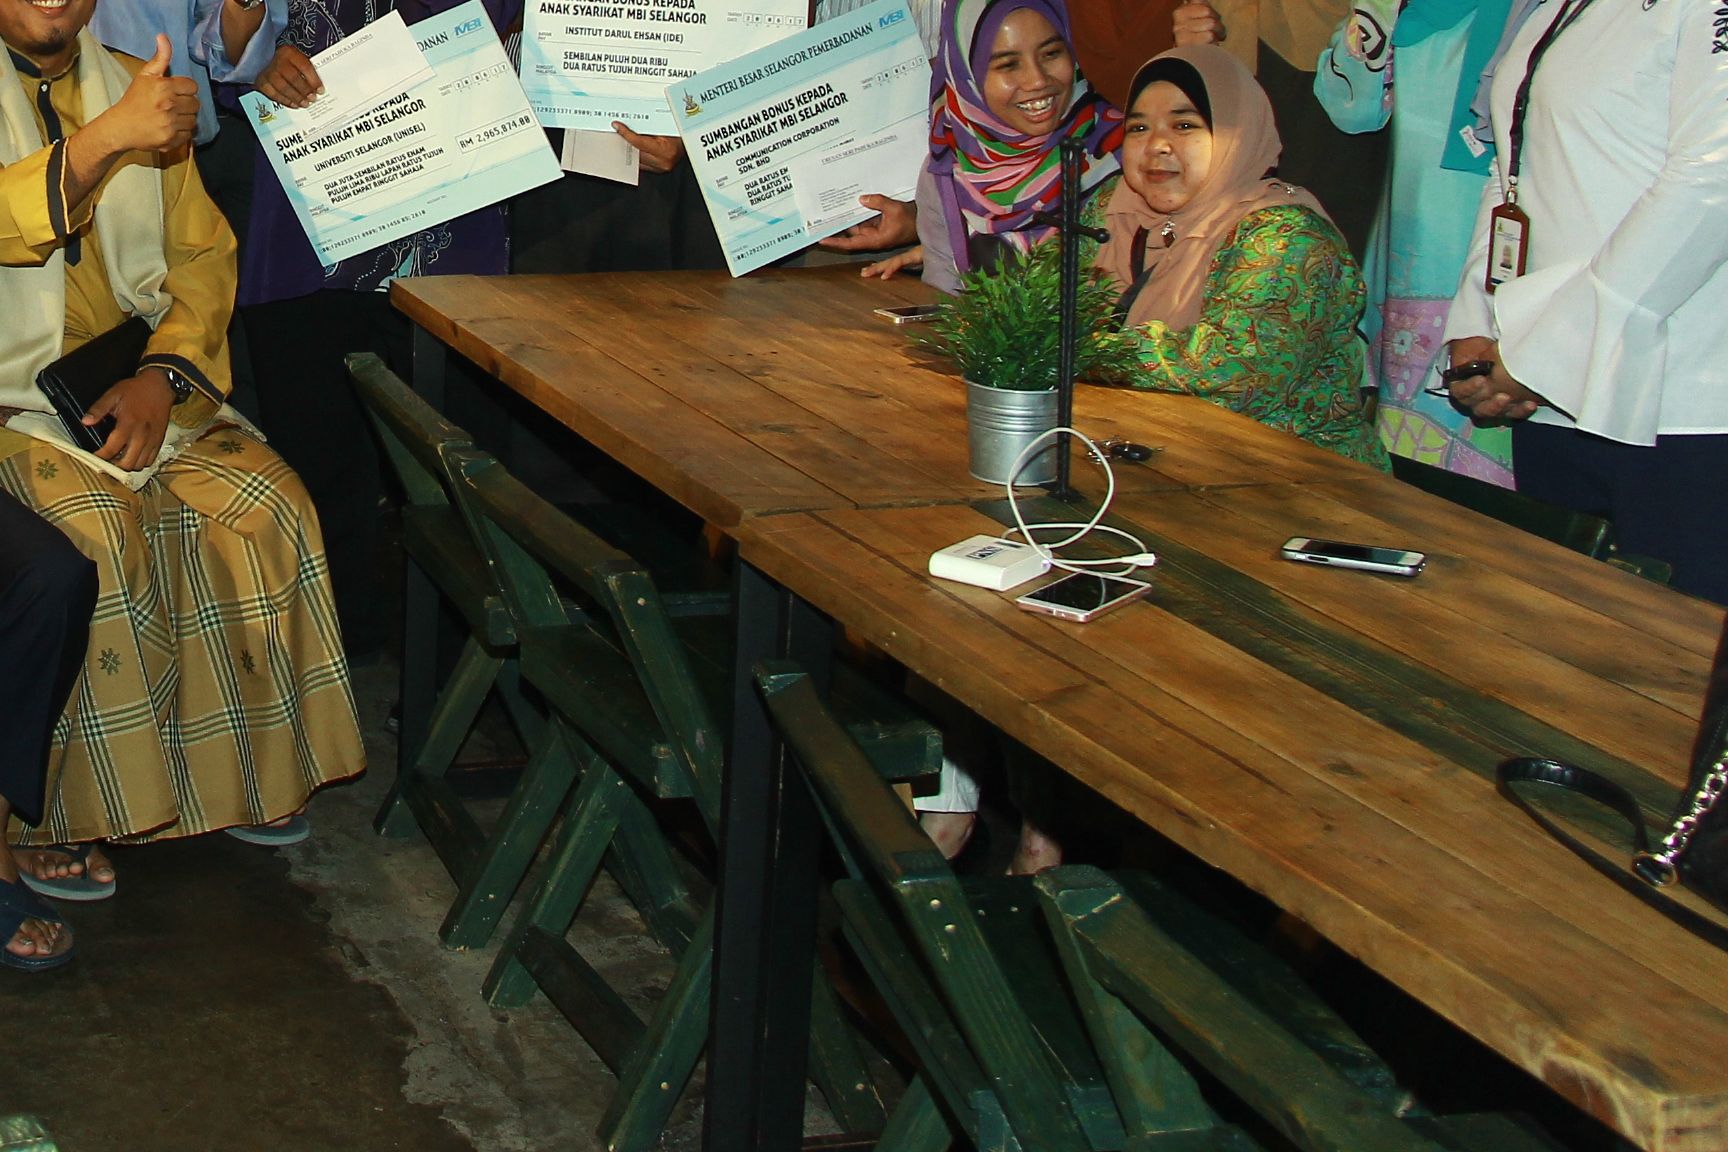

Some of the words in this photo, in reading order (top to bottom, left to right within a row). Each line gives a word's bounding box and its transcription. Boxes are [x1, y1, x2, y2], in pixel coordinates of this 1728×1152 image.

[539, 3, 569, 14] ANAK
[572, 5, 624, 18] SYARIKAT
[626, 8, 646, 20] MBI
[649, 10, 706, 24] SELANGOR
[565, 26, 603, 36] INSTITUT
[604, 28, 631, 38] DARUL
[633, 31, 661, 40] EHSAN
[662, 32, 683, 44] (IDE)
[562, 61, 580, 70] DUA
[581, 62, 606, 72] RATUS
[608, 64, 633, 74] TUJUH
[634, 66, 666, 76] RINGGIT
[563, 51, 602, 61] SEMBILAN
[603, 53, 629, 63] PULUH
[631, 55, 647, 65] DUA
[649, 57, 668, 66] RIBU
[700, 80, 738, 103] MENTERI
[738, 69, 765, 87] BESAR
[763, 51, 808, 76] SELANGOR
[807, 23, 872, 58] PEMERBADANAN
[283, 145, 310, 164] ANAK
[309, 127, 354, 152] SYARIKAT
[354, 119, 374, 134] MBI
[374, 99, 426, 127] SELANGOR
[459, 137, 474, 148] RM
[476, 116, 530, 142] 2,965,874.00
[700, 113, 761, 147] SUMBANGAN
[761, 98, 795, 121] BONUS
[795, 83, 833, 106] KEPADA
[706, 140, 734, 161] ANAK
[733, 121, 777, 149] SYARIKAT
[779, 113, 798, 129] MBI
[798, 93, 848, 121] SELANGOR
[314, 150, 355, 171] UNIVERSITI
[354, 135, 393, 156] SELANGOR
[393, 122, 425, 141] (UNISEL)
[735, 137, 792, 166] COMMUNICATION
[792, 117, 839, 142] CORPORATION
[323, 180, 338, 190] DUA
[338, 174, 354, 185] JUTA
[353, 162, 385, 178] SEMBILAN
[385, 153, 406, 166] RATUS
[406, 146, 425, 158] ENAM
[327, 184, 349, 197] PULUH
[348, 178, 365, 189] LIMA
[364, 172, 380, 182] RIBU
[380, 164, 401, 176] LAPAN
[401, 156, 422, 168] RATUS
[422, 148, 443, 159] TUJUH
[738, 163, 755, 174] SDN.
[755, 156, 770, 167] BHD
[744, 180, 759, 190] DUA
[758, 170, 779, 184] RATUS
[330, 191, 352, 204] PULUH
[351, 183, 372, 196] EMPAT
[372, 173, 398, 187] RINGGIT
[398, 164, 424, 177] SAHAJA
[747, 187, 762, 198] DUA
[761, 178, 782, 192] RATUS
[749, 189, 775, 205] RINGGIT
